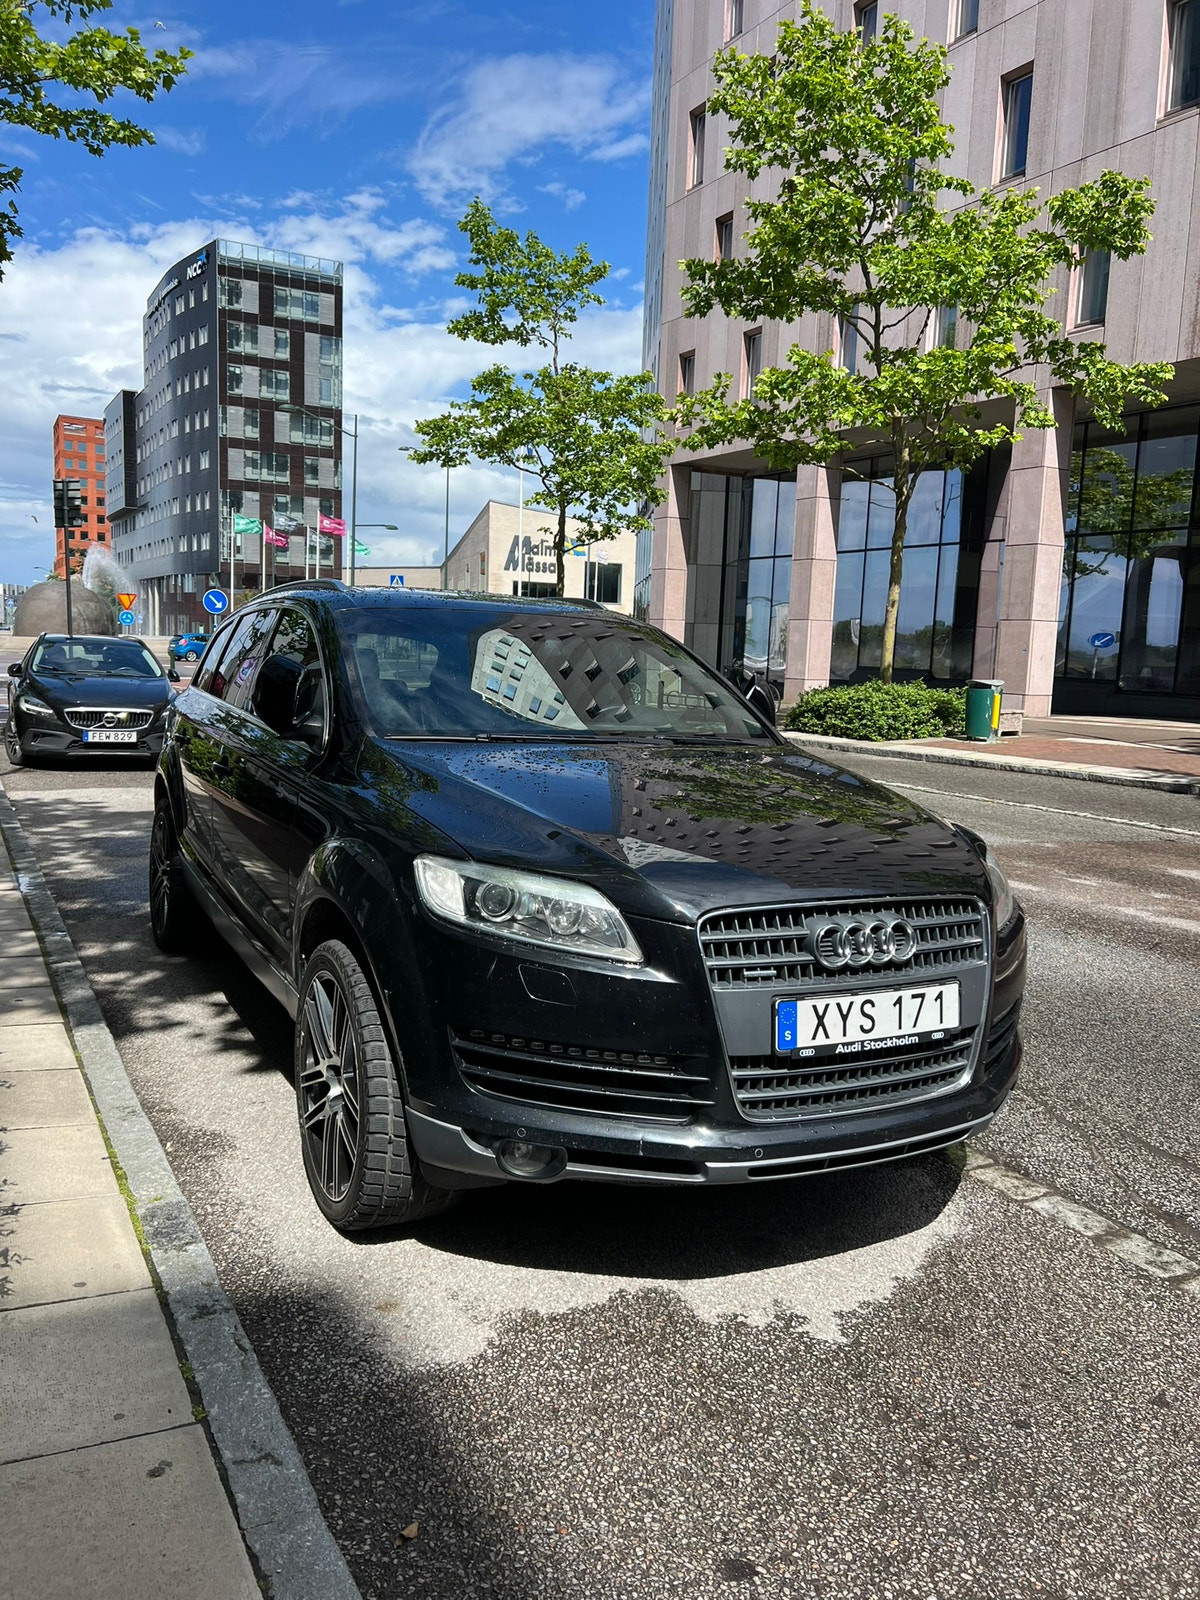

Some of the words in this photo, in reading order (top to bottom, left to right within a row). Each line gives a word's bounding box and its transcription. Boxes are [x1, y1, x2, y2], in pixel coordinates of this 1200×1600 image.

[187, 260, 202, 280] NCC
[508, 535, 557, 556] Malm
[504, 552, 557, 574] Mässa
[92, 732, 111, 741] FEW
[113, 732, 133, 741] 829
[811, 998, 876, 1041] XYS
[893, 990, 944, 1030] 171
[784, 1030, 792, 1041] S
[835, 1041, 862, 1054] Audi
[864, 1034, 919, 1051] Stockholm
